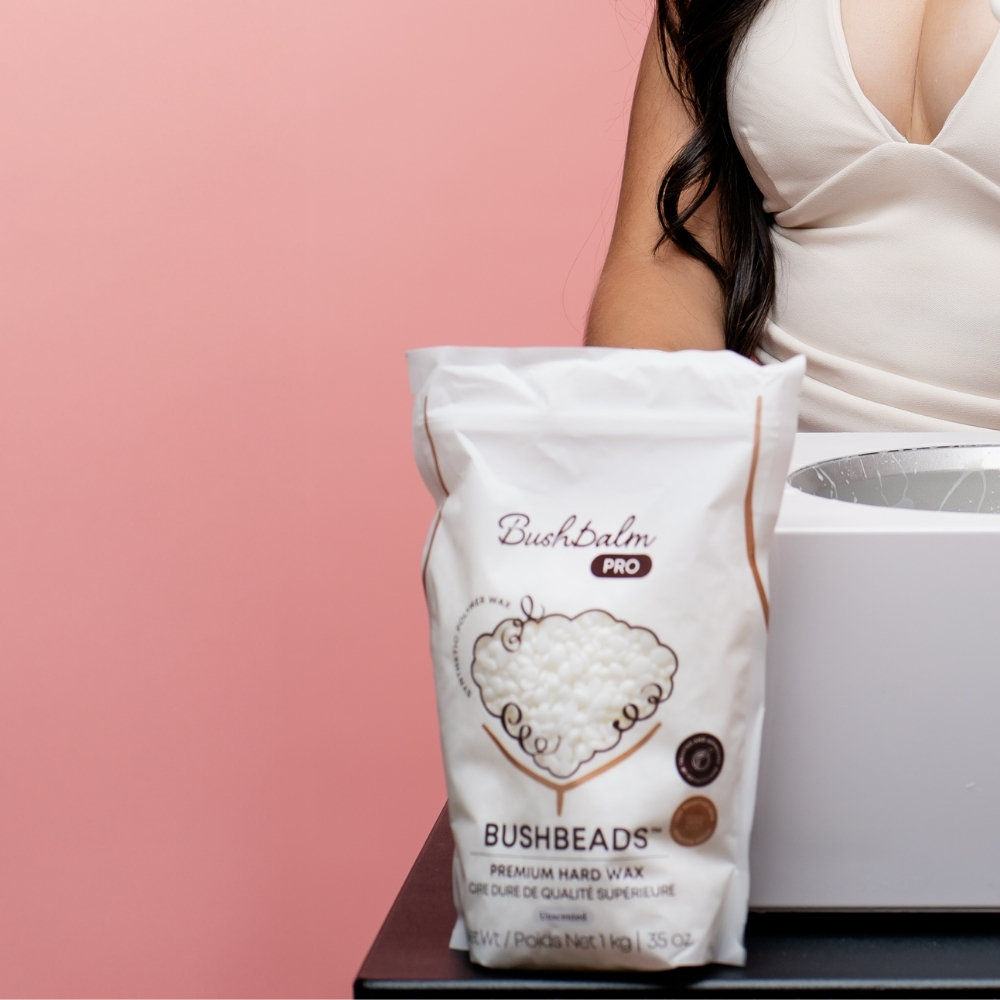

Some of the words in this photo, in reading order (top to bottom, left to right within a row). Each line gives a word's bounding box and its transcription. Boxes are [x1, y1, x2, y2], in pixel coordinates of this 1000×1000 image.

[498, 513, 656, 548] Bushbalm
[602, 557, 641, 575] PRO
[490, 863, 554, 880] PREMIUM
[558, 867, 601, 881] HARD
[606, 866, 645, 881] WAX
[491, 883, 520, 898] DURE
[522, 885, 539, 899] DE
[514, 929, 562, 949] Poids
[565, 931, 597, 950] Net
[609, 932, 632, 954] kg
[647, 931, 668, 950] 35
